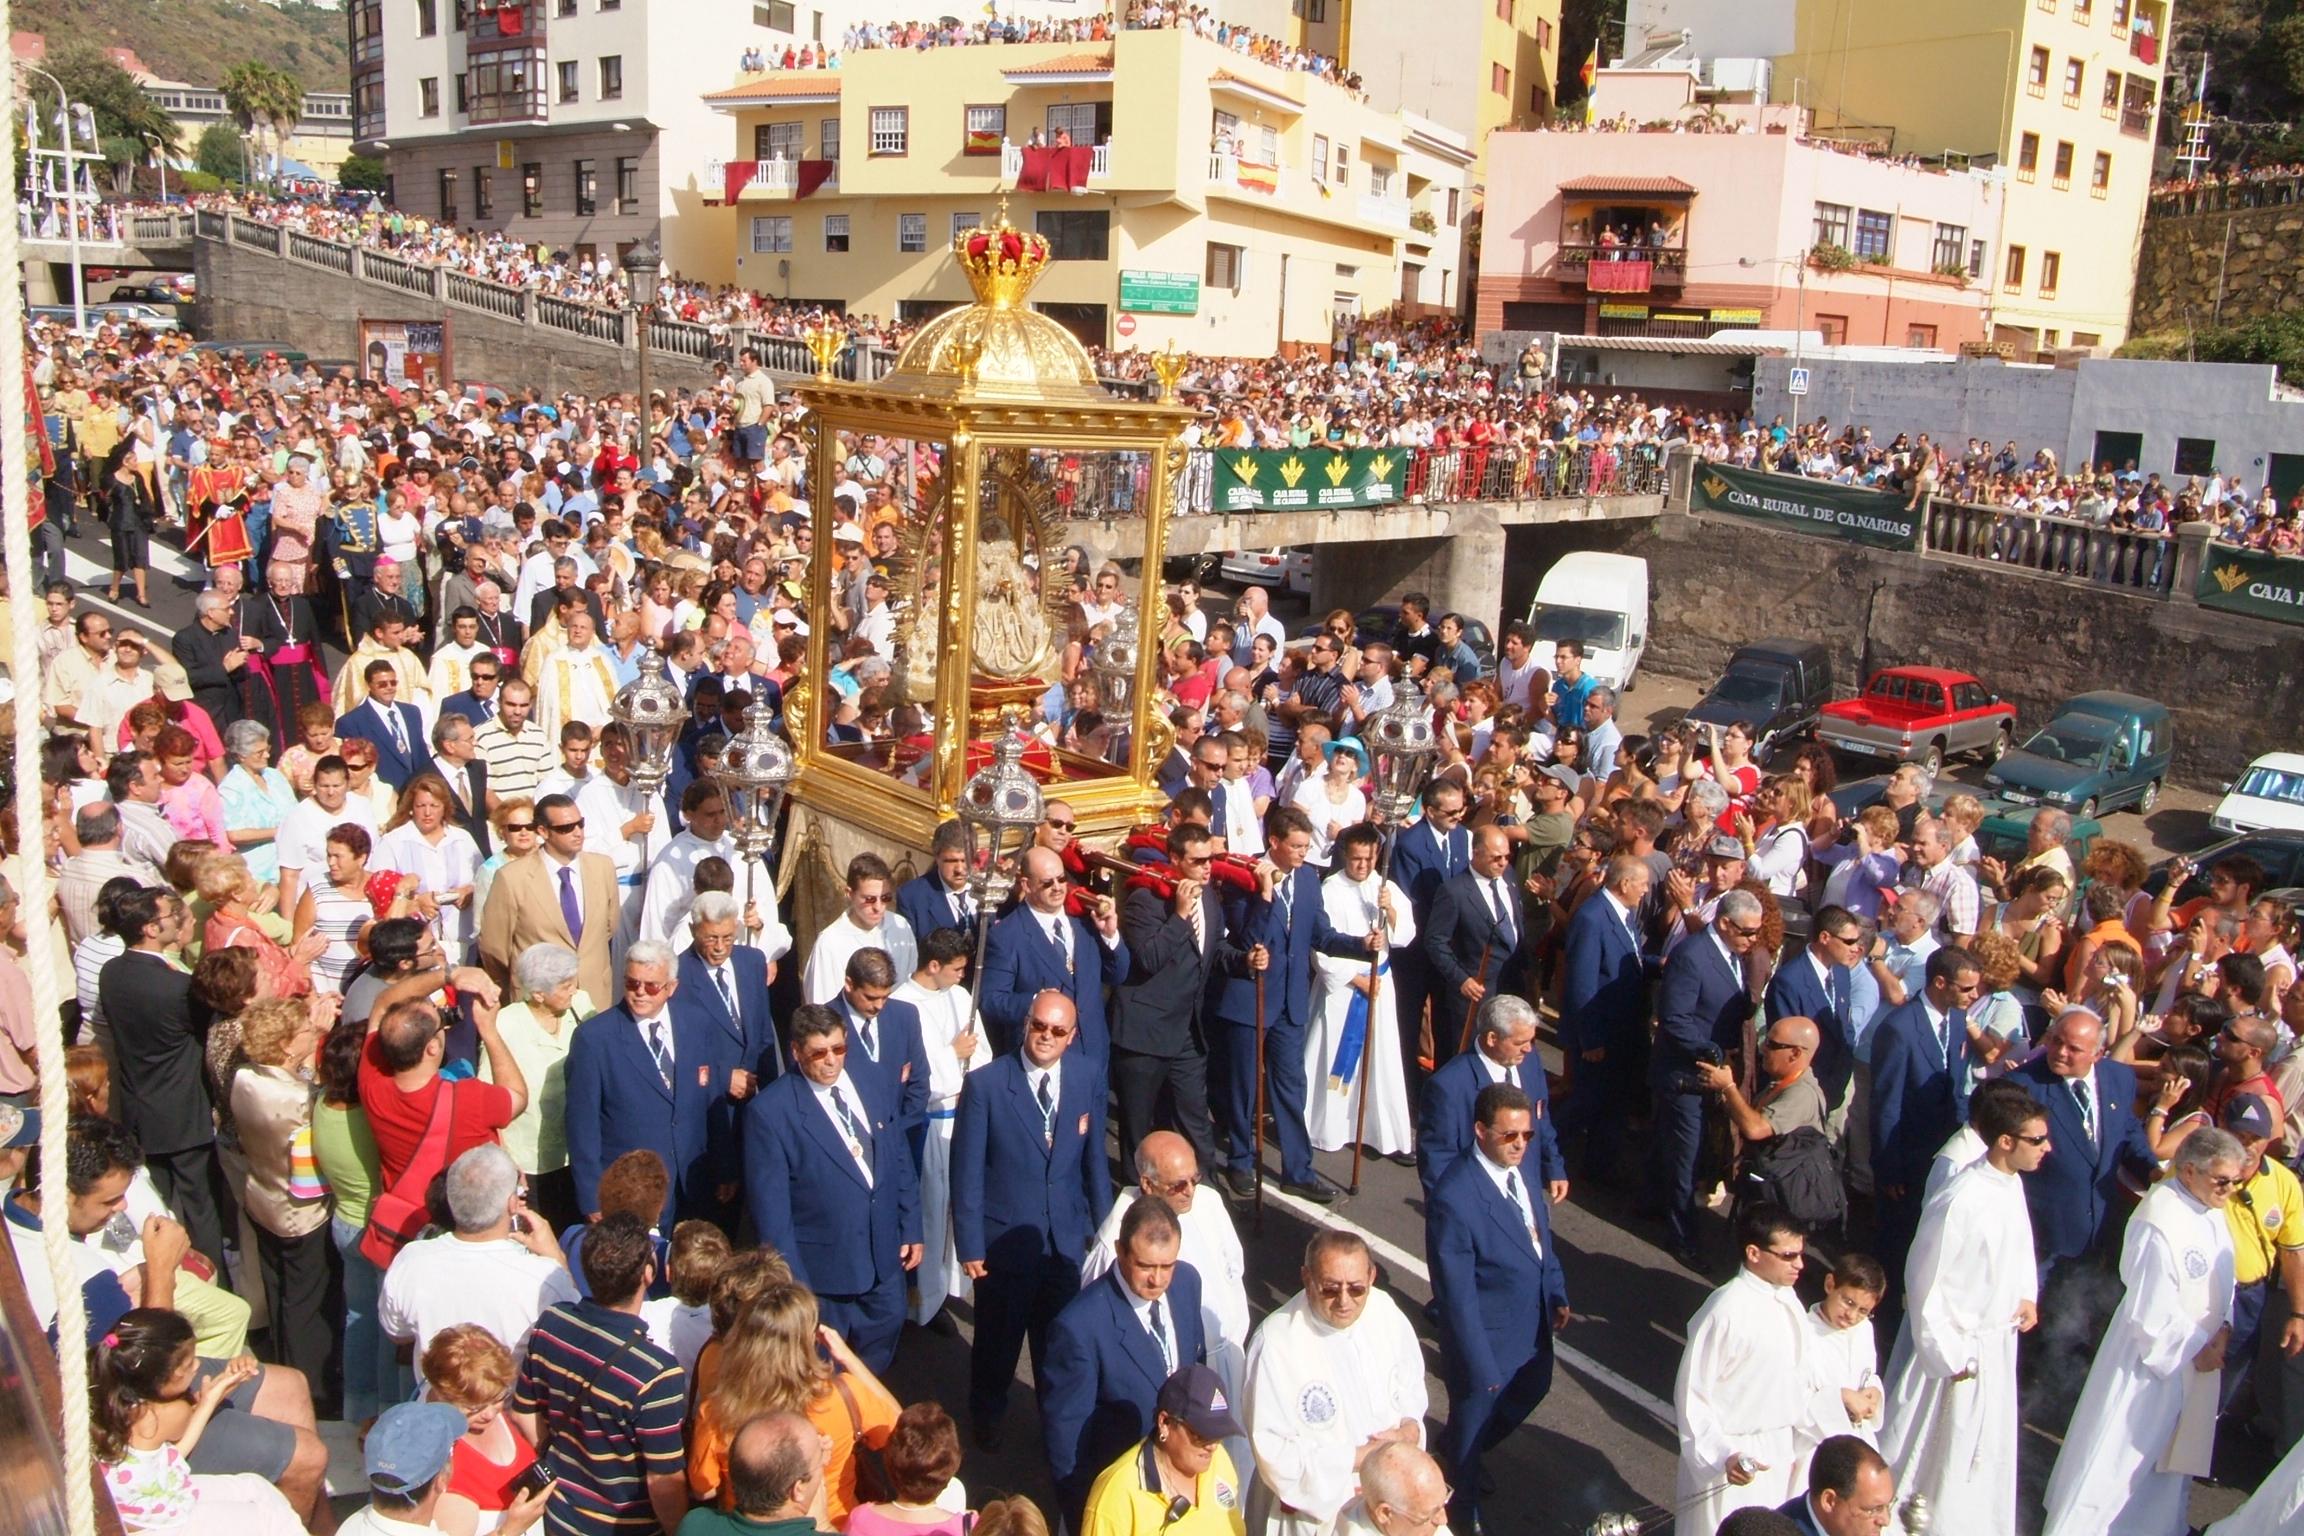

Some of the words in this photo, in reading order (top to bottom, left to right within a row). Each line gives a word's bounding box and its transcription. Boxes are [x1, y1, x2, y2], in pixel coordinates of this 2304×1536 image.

[1728, 490, 1760, 508] CAJA
[1762, 498, 1809, 517] RURAL
[1813, 507, 1835, 522] DE
[1837, 512, 1911, 537] CANARIAS
[2248, 582, 2294, 605] CAJA
